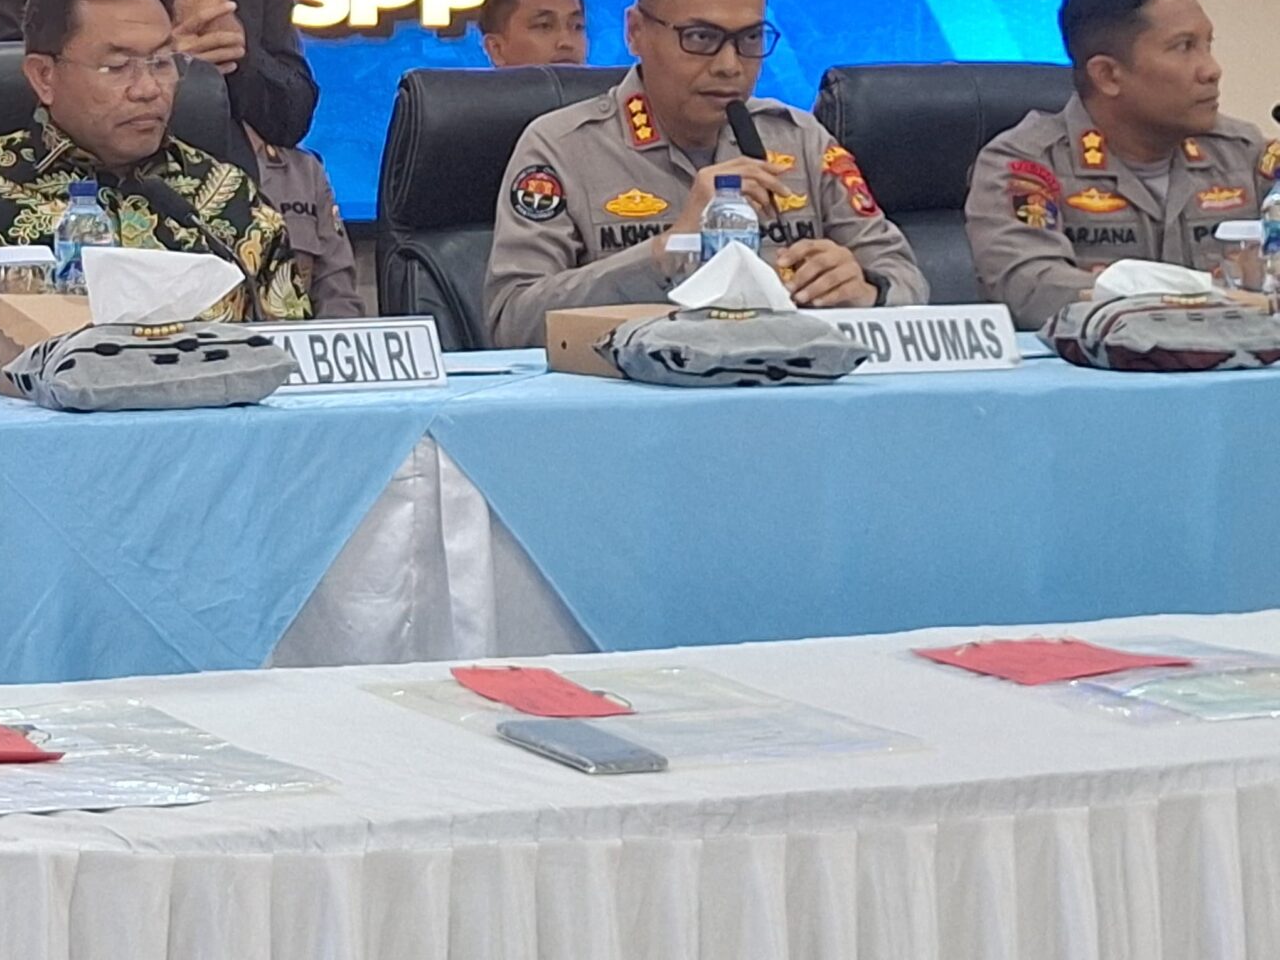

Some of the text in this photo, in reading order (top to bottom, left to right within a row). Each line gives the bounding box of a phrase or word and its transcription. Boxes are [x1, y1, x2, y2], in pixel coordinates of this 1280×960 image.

[308, 331, 382, 384] BGN
[384, 330, 419, 381] RI
[895, 317, 1004, 363] HUMAS
